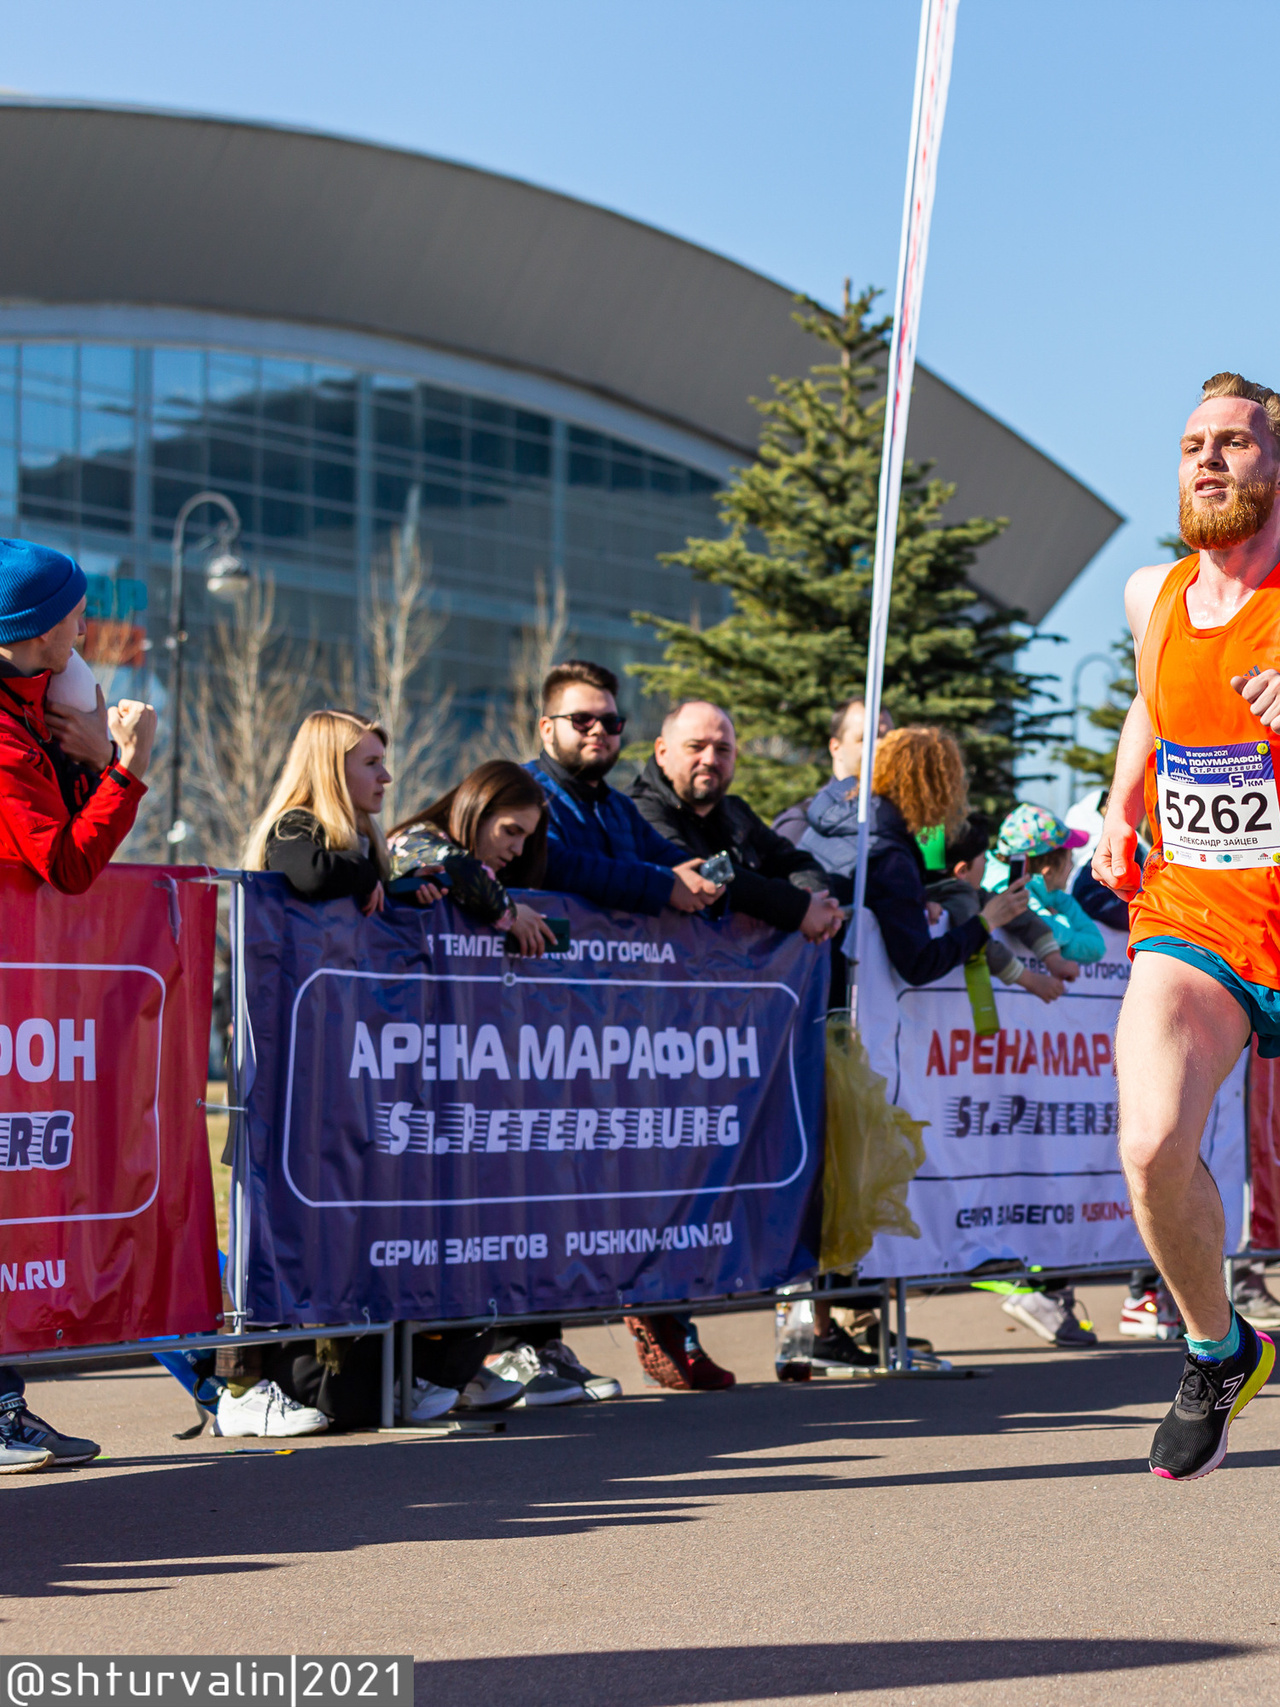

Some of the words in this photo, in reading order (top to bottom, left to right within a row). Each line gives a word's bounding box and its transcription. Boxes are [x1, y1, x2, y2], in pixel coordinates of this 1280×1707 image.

[1189, 754, 1262, 766] ПОЛУМАРАФОН
[1230, 774, 1244, 788] 5
[1166, 789, 1272, 834] 5262
[1179, 836, 1221, 847] АЛЕКСАНДР
[1223, 837, 1259, 847] ЗАЙЦЕВ
[608, 941, 676, 964] ГОРОДА
[349, 1021, 511, 1081] АРЕНА
[519, 1024, 761, 1081] МАРАФОН
[369, 1239, 438, 1268] СЕРИЯ
[444, 1234, 549, 1265] ЗАБЕГОВ
[565, 1220, 734, 1258] PUSHKIN-RUN.RU
